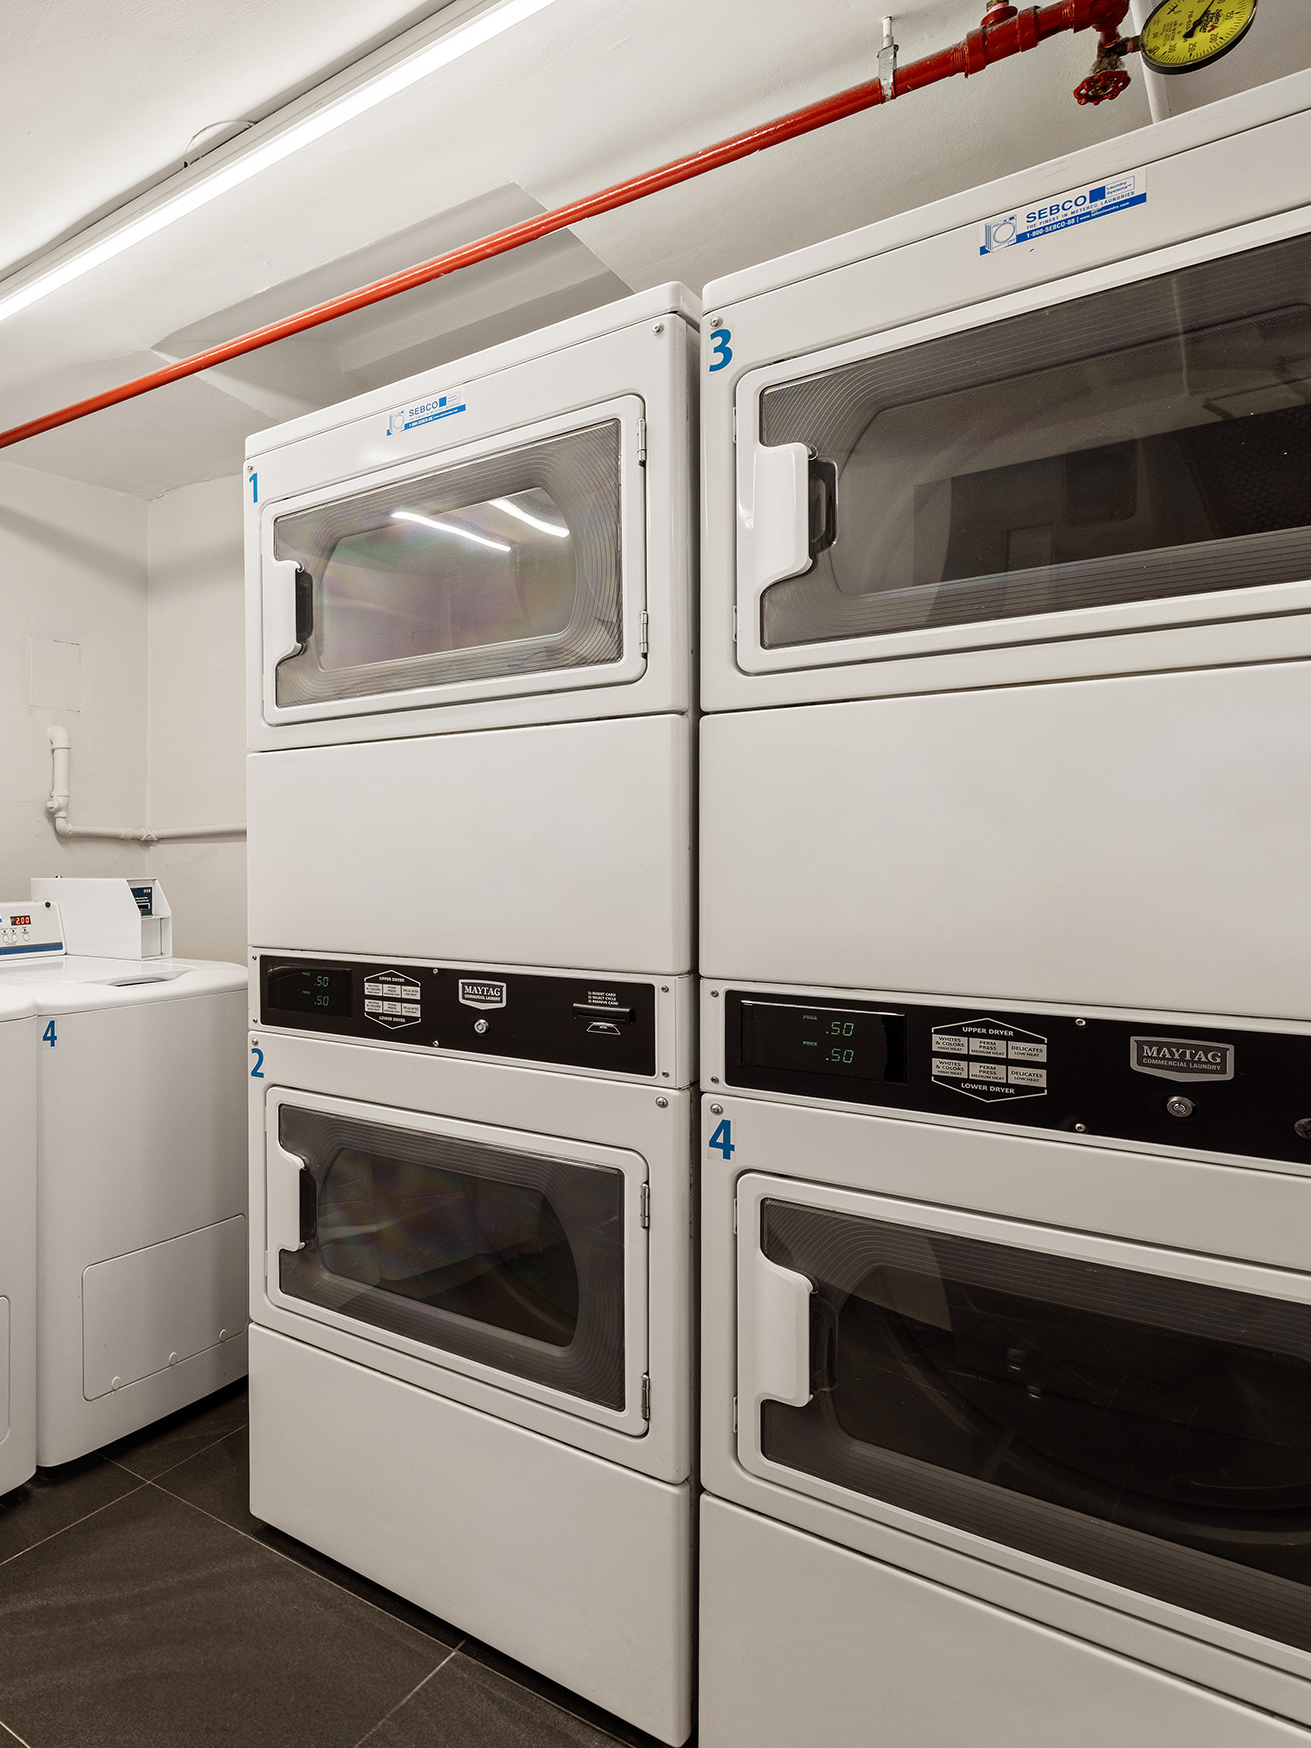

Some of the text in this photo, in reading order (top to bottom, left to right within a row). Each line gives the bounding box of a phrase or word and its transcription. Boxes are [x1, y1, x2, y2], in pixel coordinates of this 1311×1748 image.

[1026, 195, 1087, 223] SEBCO
[1039, 216, 1059, 226] FINEST
[1100, 191, 1135, 205] LAUNDRIES
[709, 329, 732, 372] 3
[409, 401, 438, 417] SEBCO
[249, 472, 258, 503] 1
[314, 976, 329, 987] .50
[464, 985, 500, 996] MAYTAG
[314, 995, 329, 1006] .50
[42, 1020, 57, 1047] 4
[826, 1022, 854, 1036] .50
[988, 1028, 1014, 1036] DRYER
[826, 1048, 854, 1063] .50
[1142, 1045, 1221, 1063] MAYTAG
[251, 1048, 264, 1078] 2
[1143, 1058, 1187, 1067] COMMERCIAL
[961, 1082, 1015, 1094] LOWER DRYER
[709, 1120, 735, 1160] 4
